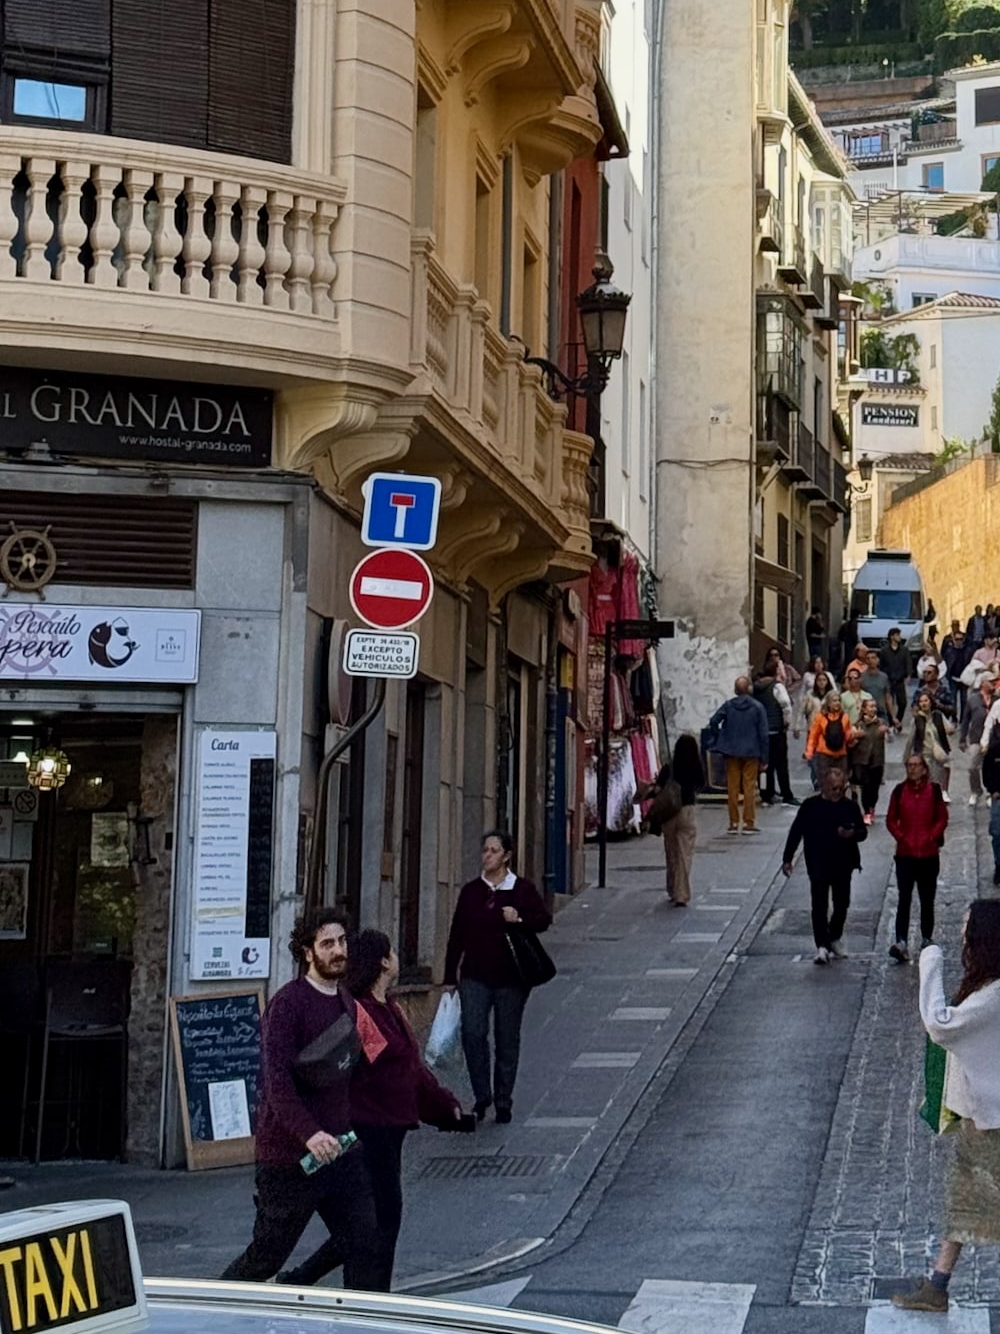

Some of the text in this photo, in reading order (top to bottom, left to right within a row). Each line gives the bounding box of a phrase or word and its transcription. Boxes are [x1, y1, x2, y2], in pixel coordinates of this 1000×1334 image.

[30, 384, 252, 436] GRANADA
[118, 433, 251, 452] www.hostal-granada.com
[0, 638, 73, 662] pera
[361, 645, 403, 654] EXCEPTO
[351, 661, 410, 671] AUTORIZADOS
[352, 653, 411, 663] VEHICULOS
[210, 738, 240, 751] Carta
[0, 1229, 99, 1332] TAXI
